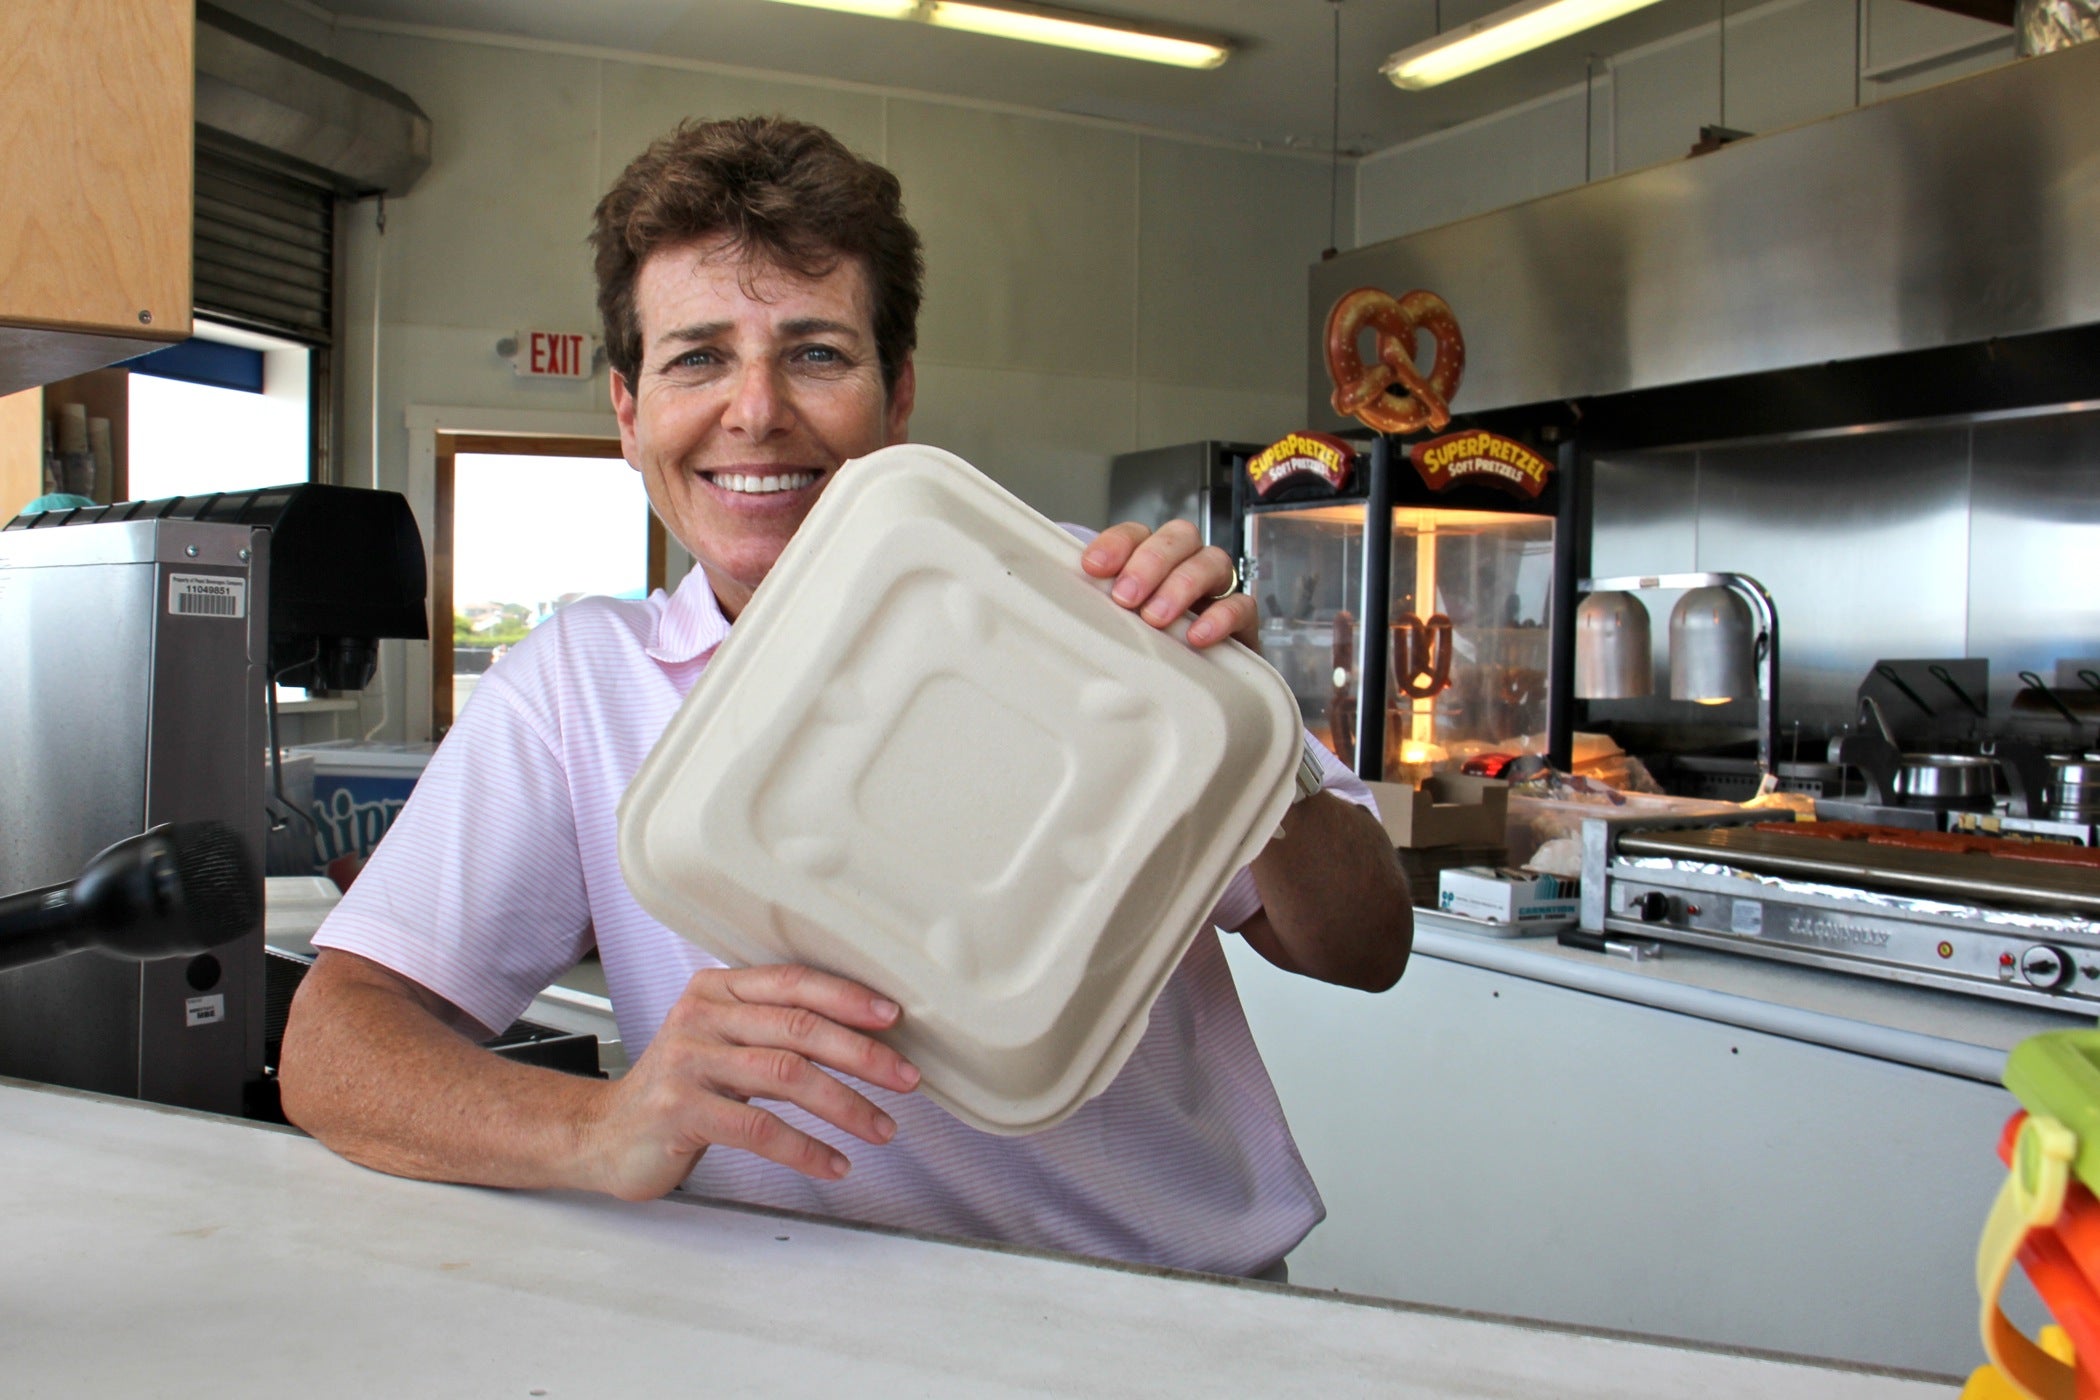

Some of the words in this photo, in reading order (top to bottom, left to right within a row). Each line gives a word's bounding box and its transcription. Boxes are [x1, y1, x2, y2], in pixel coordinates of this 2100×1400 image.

[531, 332, 583, 375] EXIT
[1249, 433, 1340, 481] SUPERPRETZEL
[1269, 461, 1292, 482] SOFT
[1423, 433, 1545, 482] SUPERPRETZEL
[1448, 460, 1474, 477] SOFT
[1475, 458, 1523, 482] PRETZELS
[187, 585, 230, 594] 11049851
